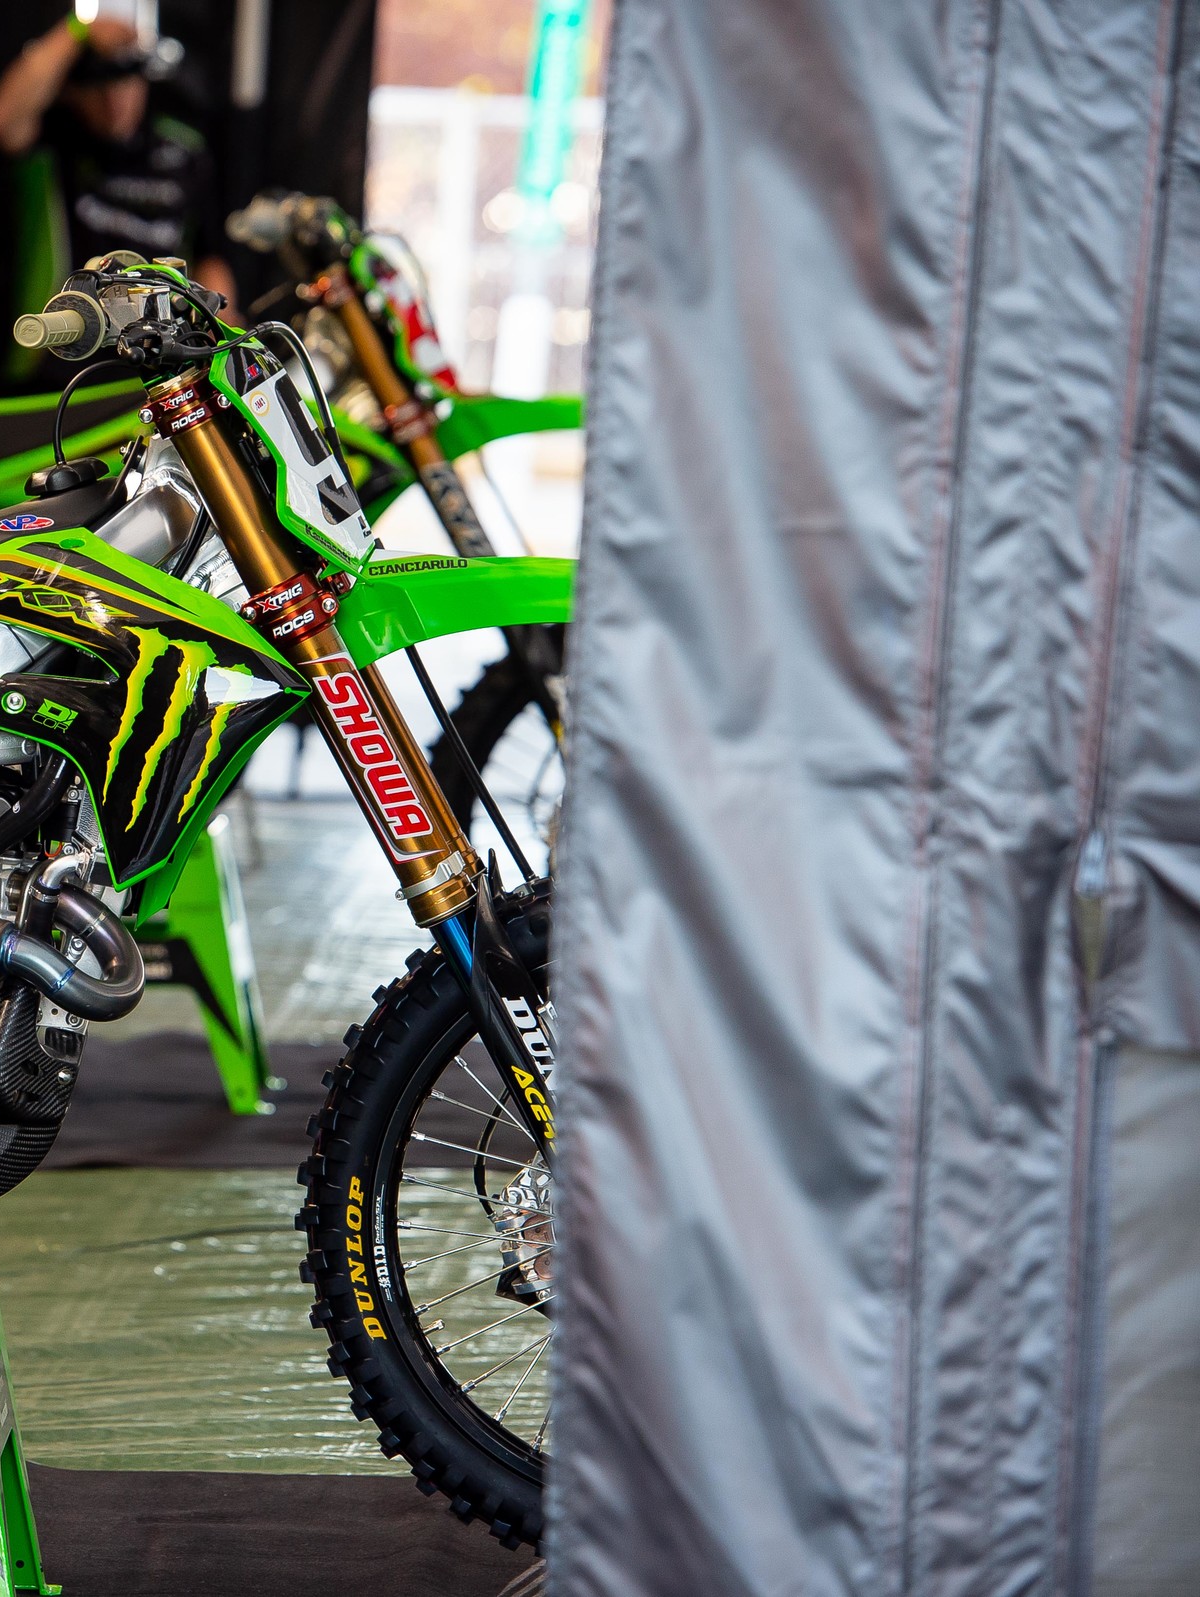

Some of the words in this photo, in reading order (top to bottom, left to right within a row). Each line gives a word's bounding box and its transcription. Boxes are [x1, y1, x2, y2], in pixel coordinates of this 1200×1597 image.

[160, 390, 193, 411] XTRIG
[171, 407, 205, 430] ROCS
[0, 515, 37, 530] VP
[368, 558, 468, 577] CIANCIARULO
[256, 582, 303, 614] XTRIG
[272, 609, 315, 638] ROCS
[312, 672, 433, 840] SHOWA
[346, 1176, 388, 1341] DUNLOP
